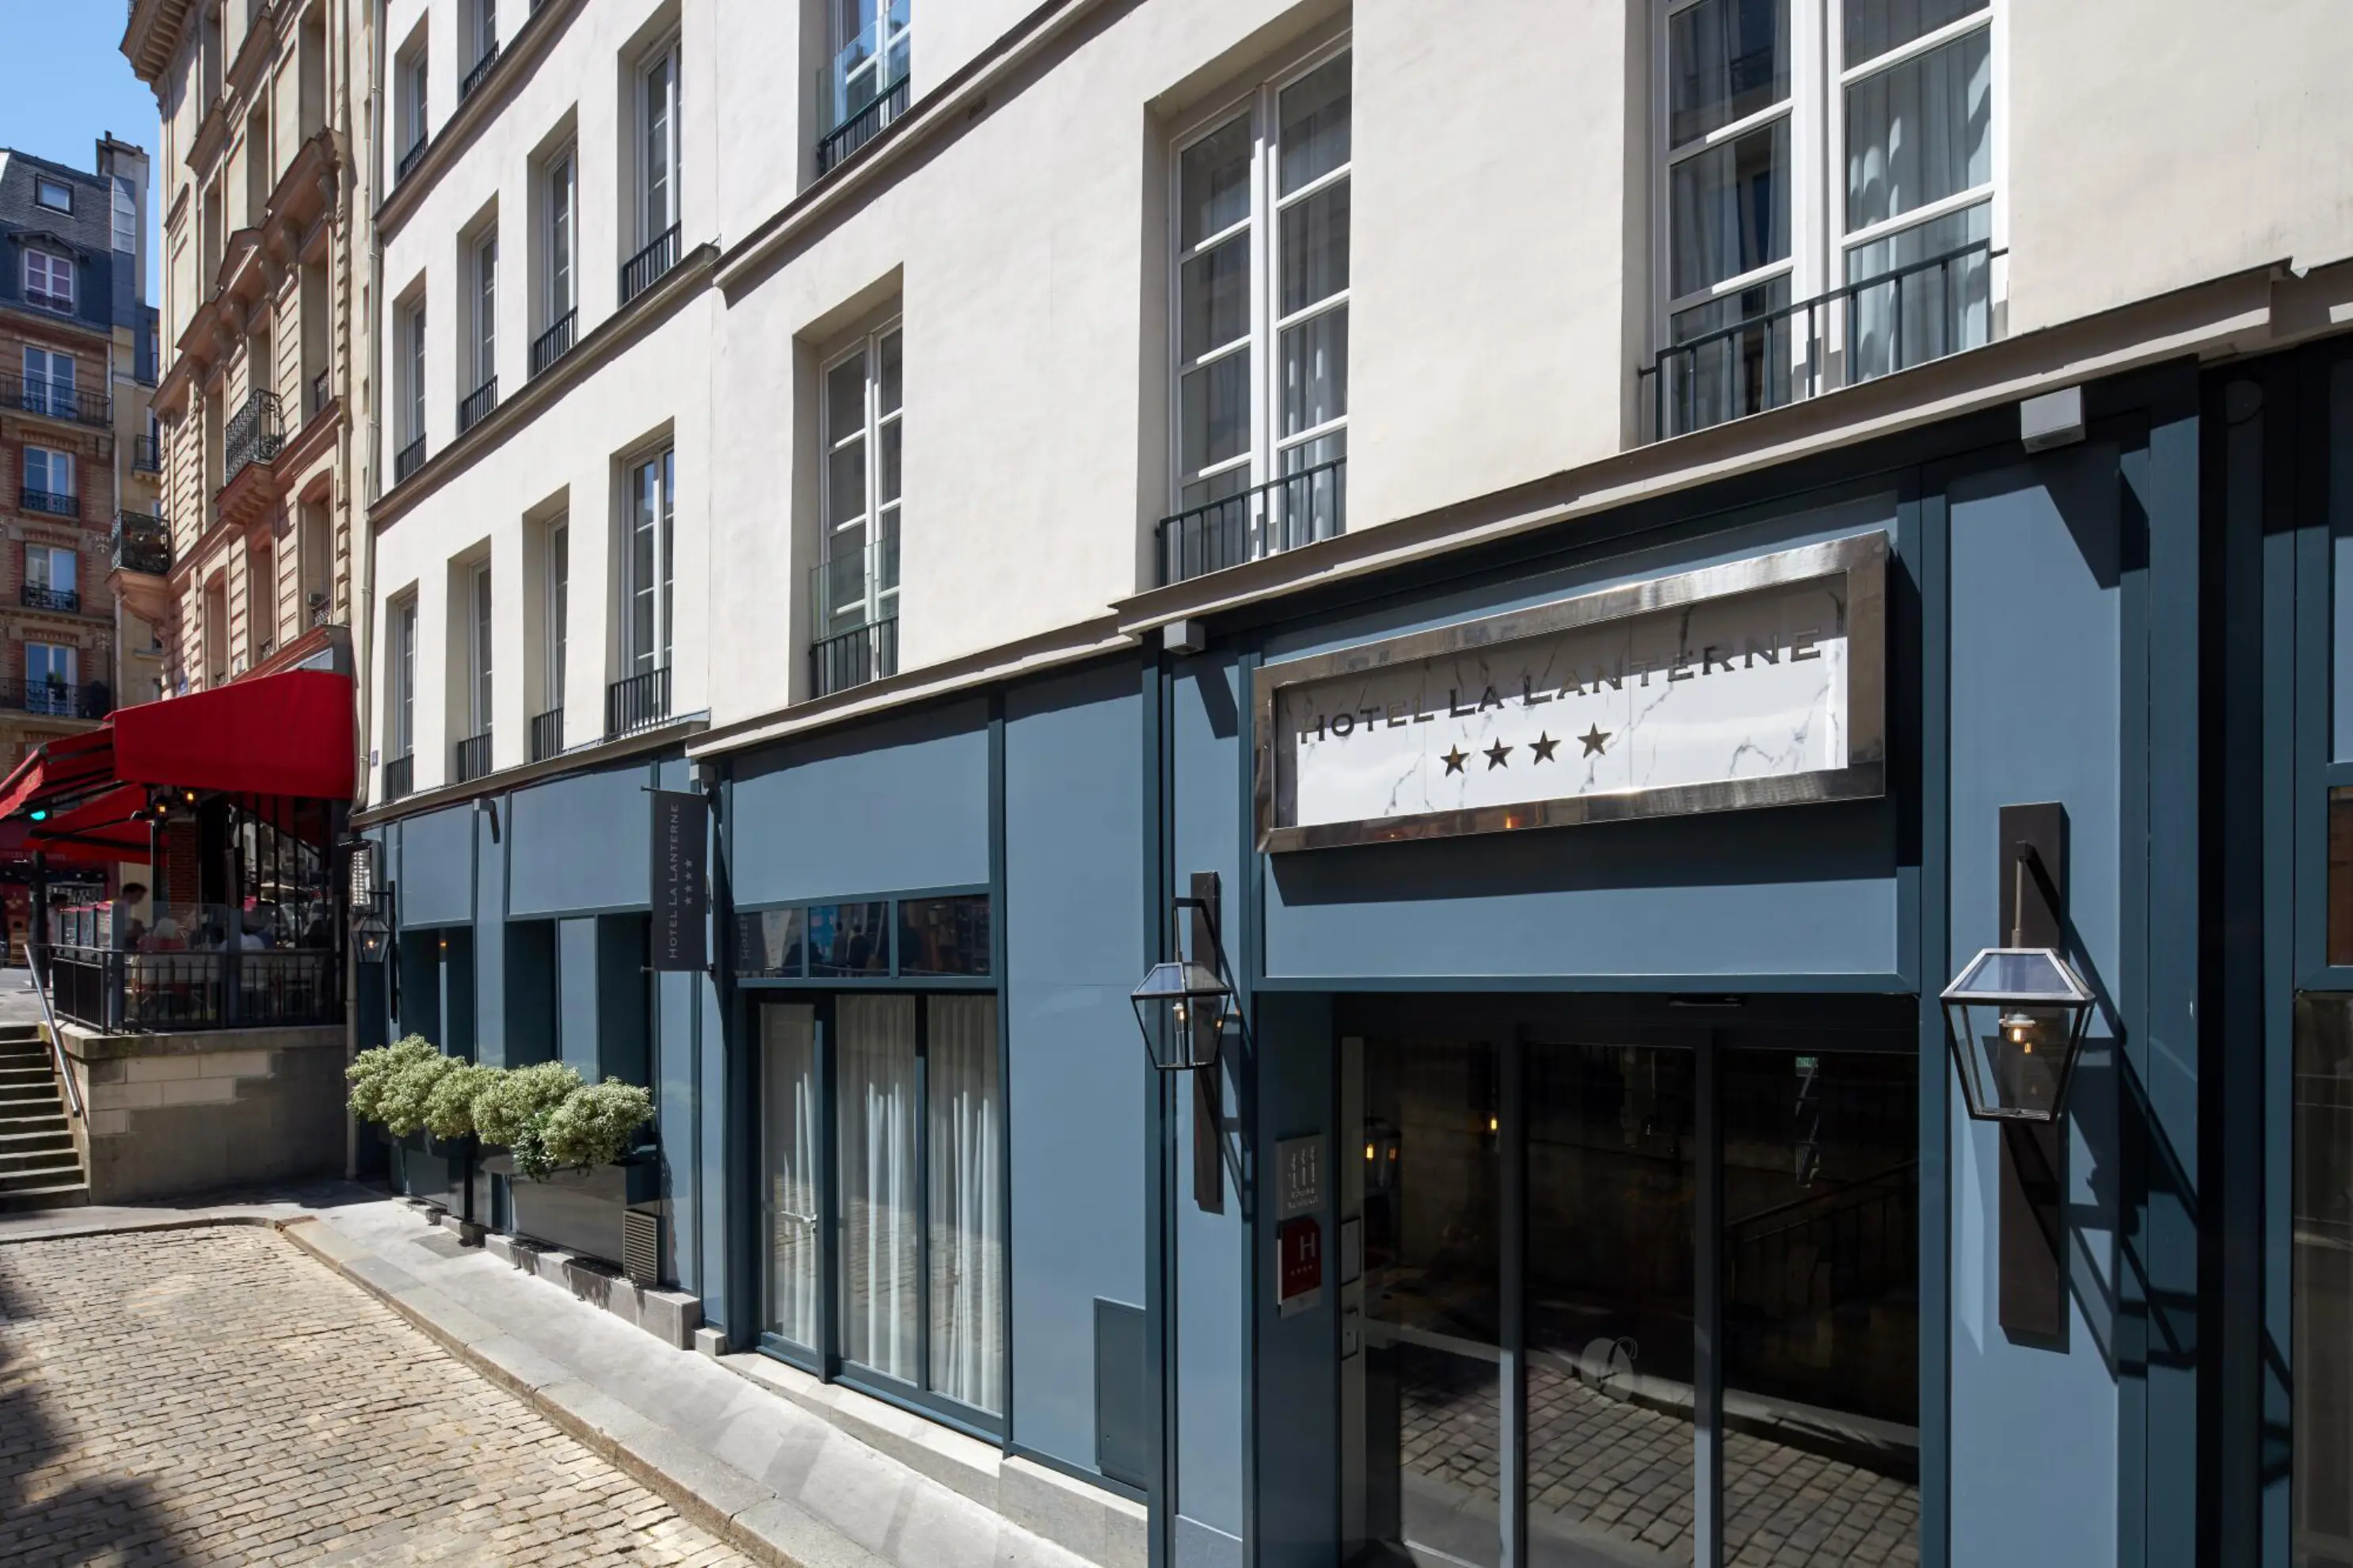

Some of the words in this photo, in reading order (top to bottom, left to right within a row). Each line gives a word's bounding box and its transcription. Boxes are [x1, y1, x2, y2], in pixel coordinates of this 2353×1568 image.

[1300, 692, 1435, 744] HOTEL
[1449, 685, 1505, 718] LA
[1522, 627, 1822, 707] LANTERNE
[668, 803, 680, 882] LANTERNE
[668, 887, 679, 906] LA
[668, 910, 679, 959] HOTEL
[1299, 1232, 1315, 1262] H
